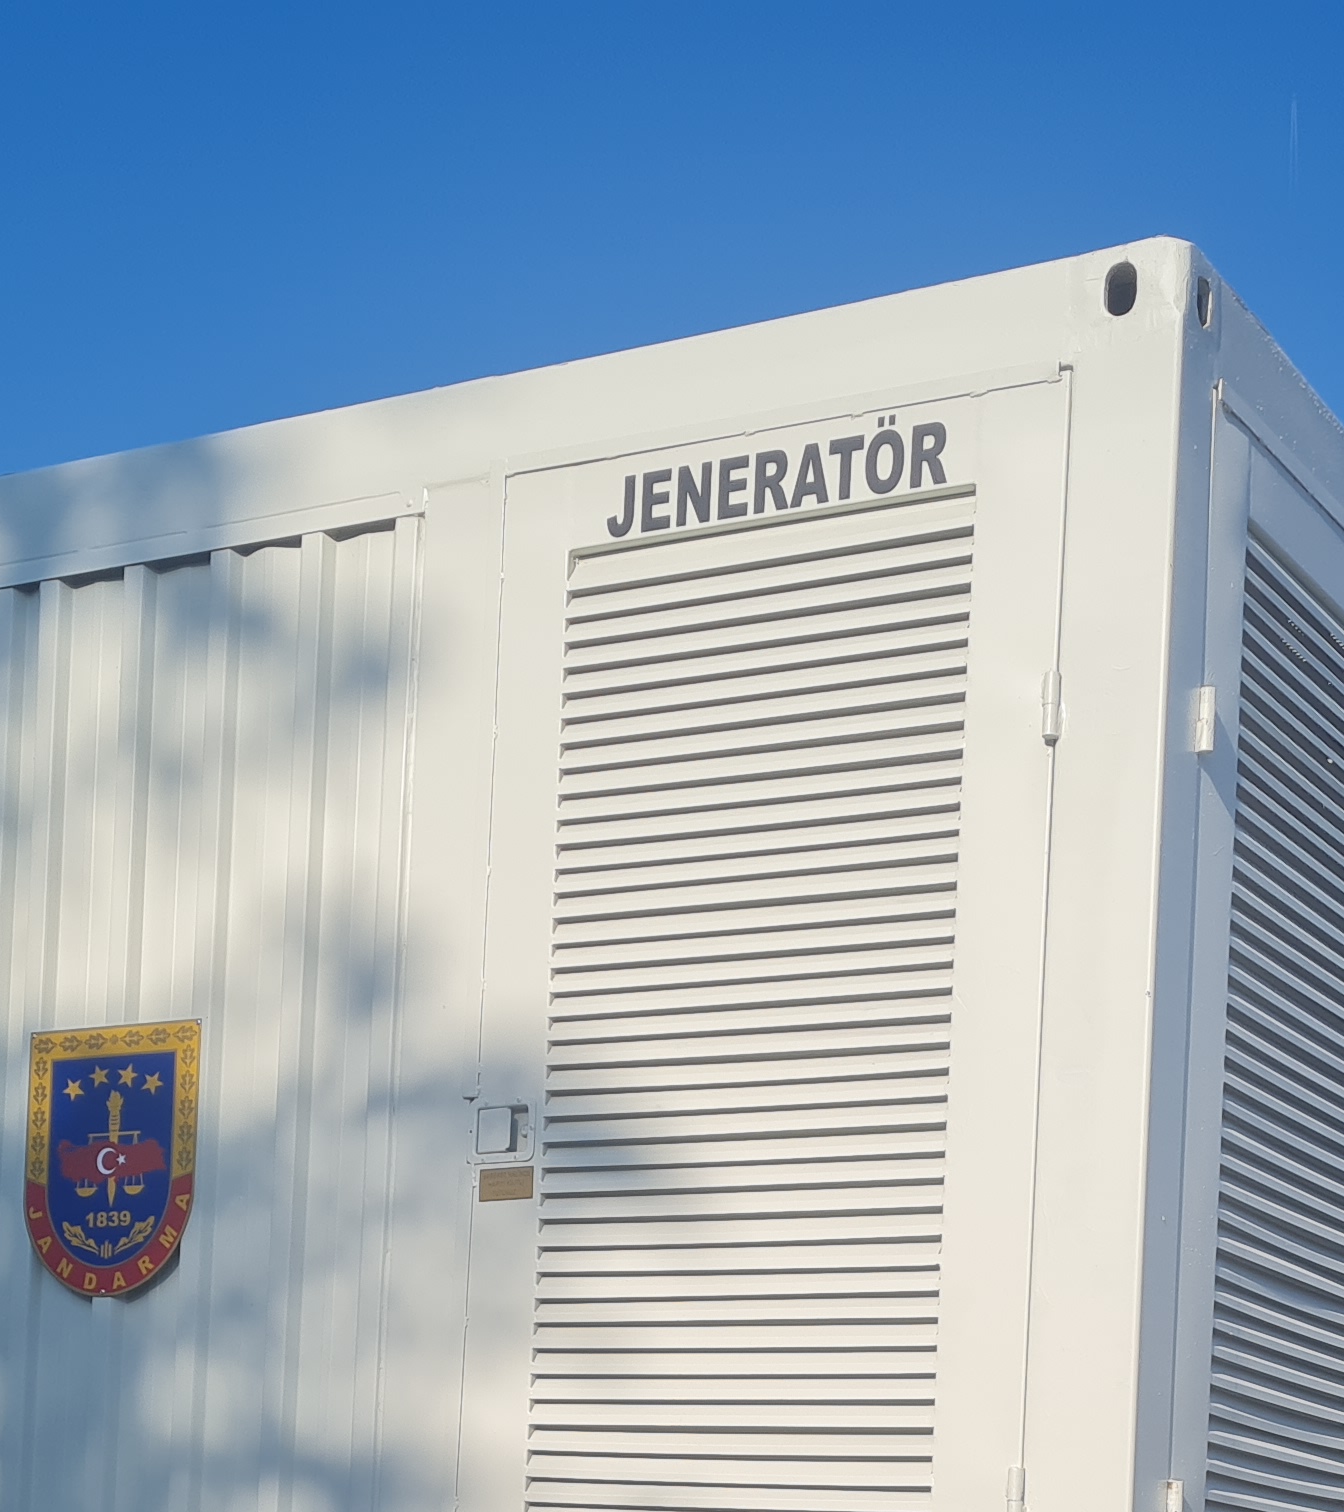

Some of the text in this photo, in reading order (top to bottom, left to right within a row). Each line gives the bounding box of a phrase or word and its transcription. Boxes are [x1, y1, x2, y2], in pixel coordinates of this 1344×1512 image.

[605, 414, 947, 538] JENERATÖR
[28, 1192, 191, 1290] JANDARMA
[85, 1210, 131, 1228] 1839
